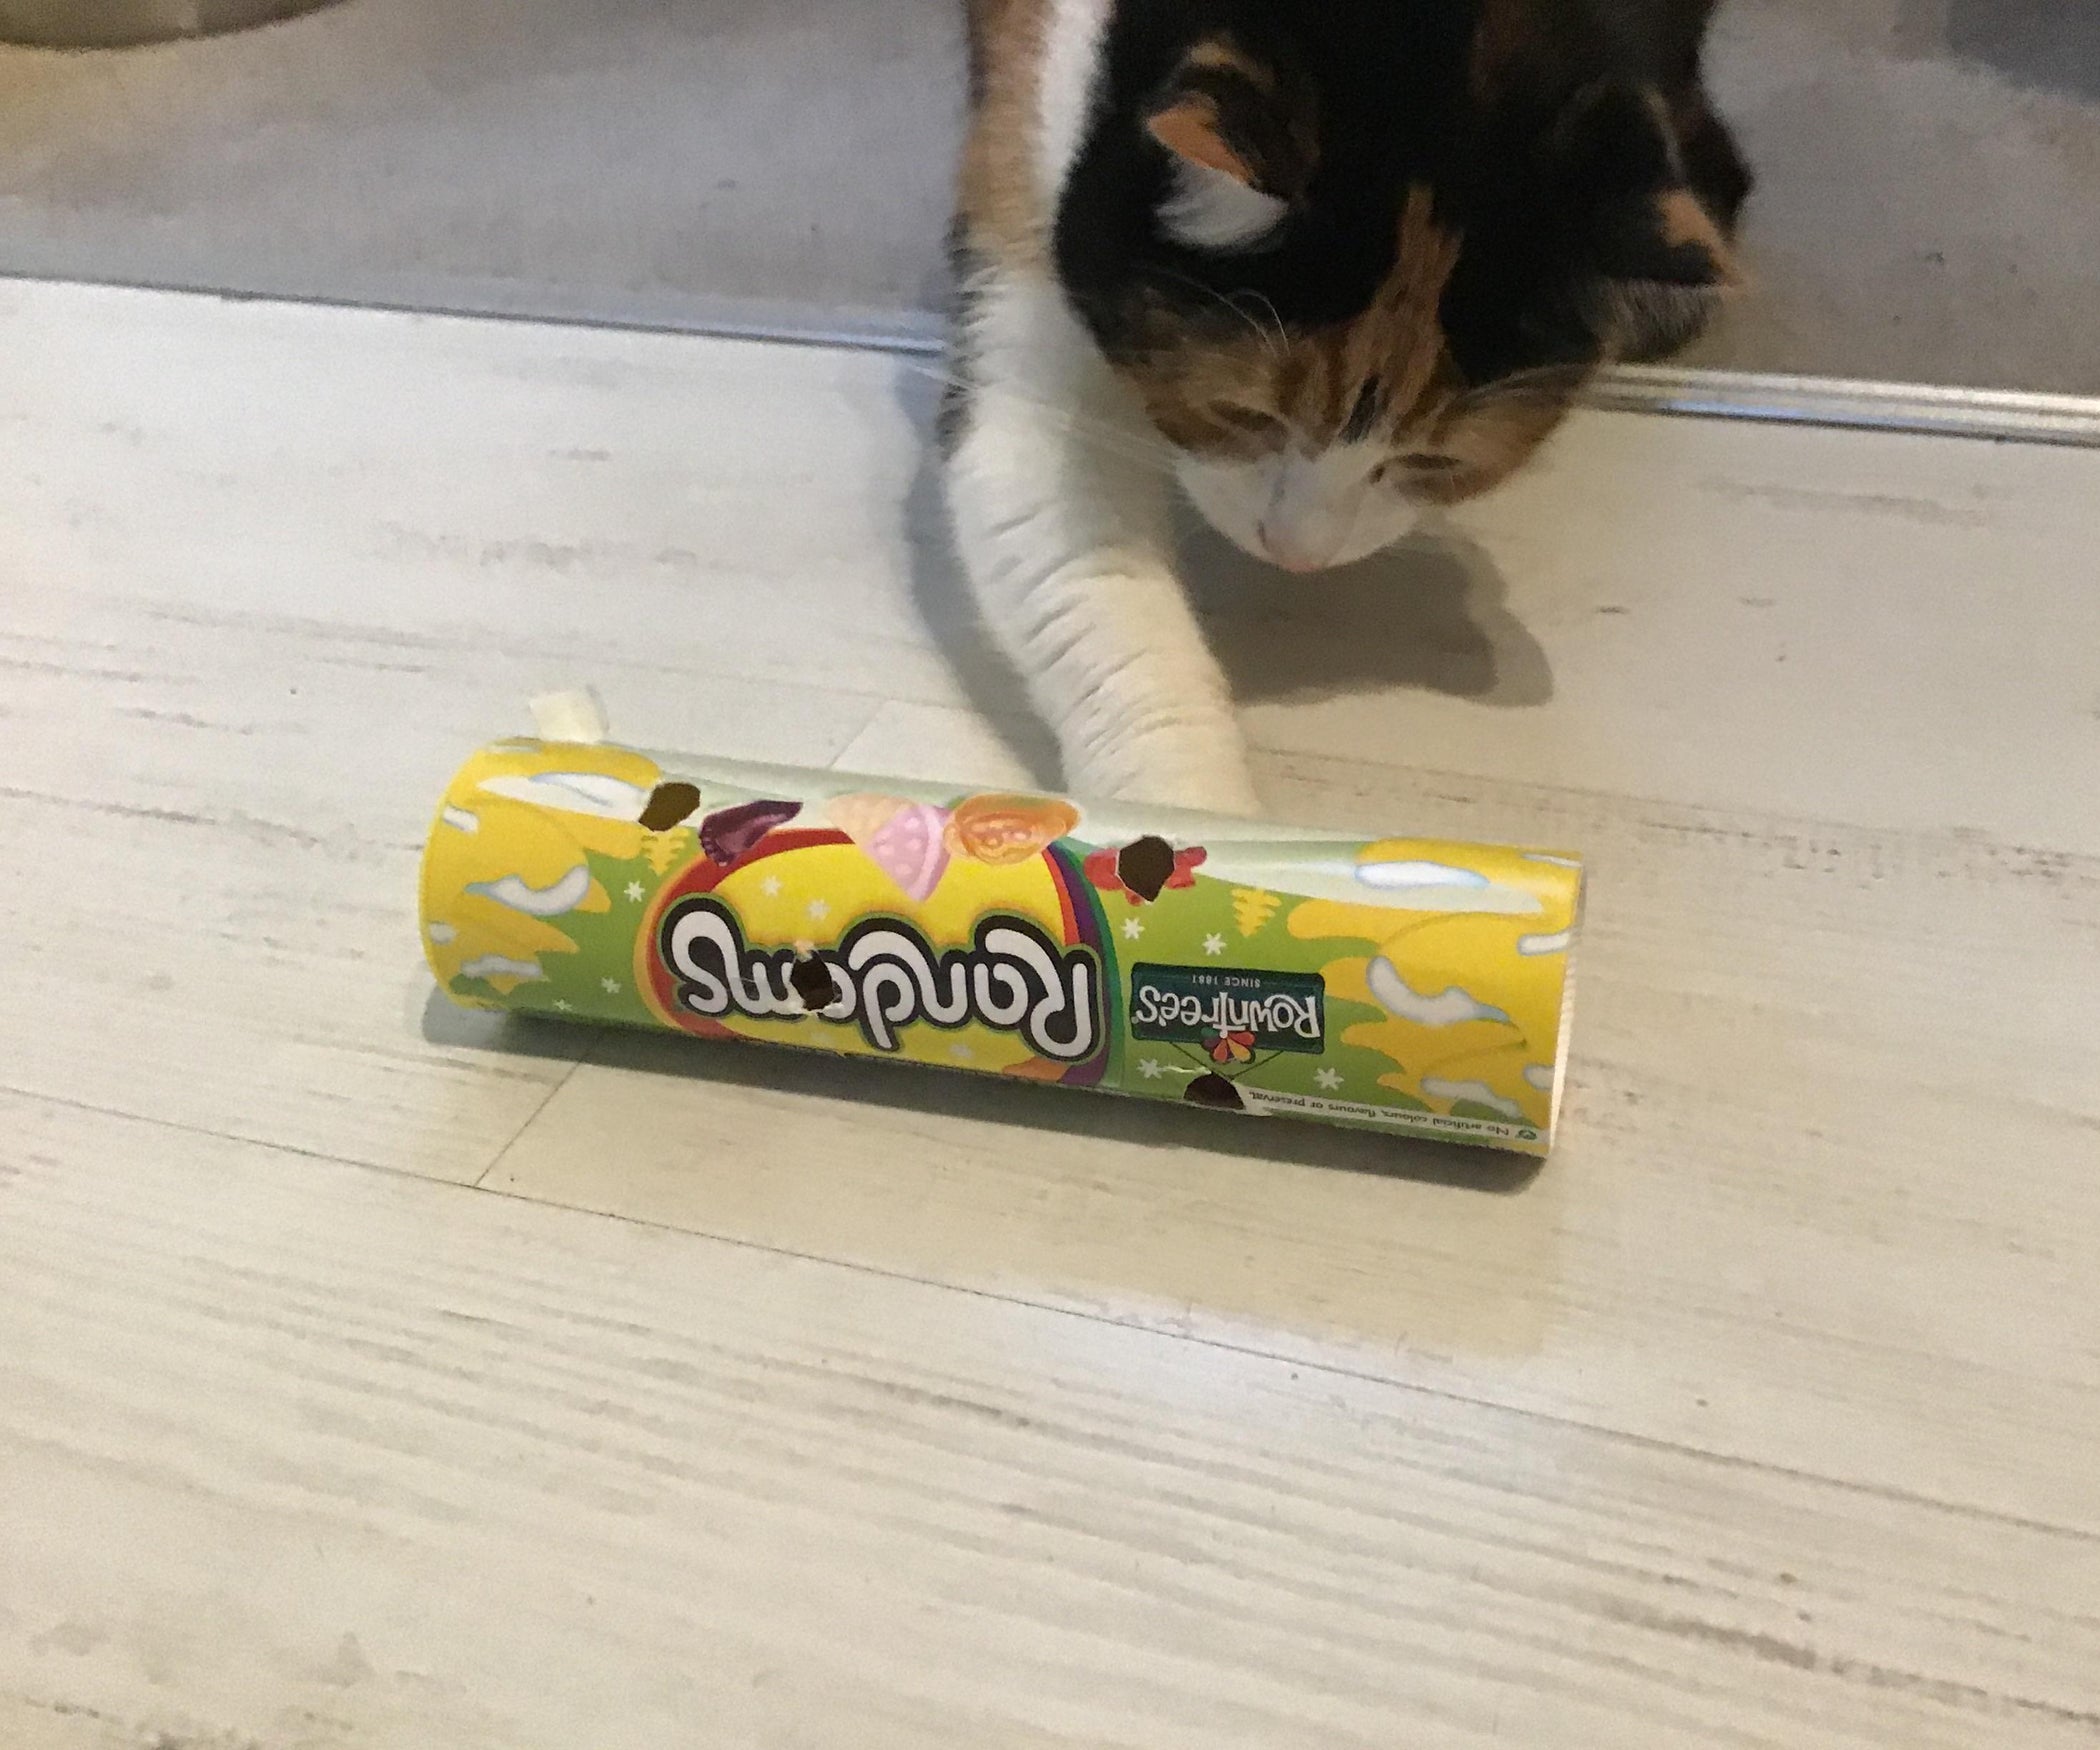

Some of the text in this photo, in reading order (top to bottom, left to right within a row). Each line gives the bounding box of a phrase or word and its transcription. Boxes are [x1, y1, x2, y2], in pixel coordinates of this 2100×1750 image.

[1192, 974, 1261, 988] SINCE 1881
[1309, 1101, 1324, 1109] or
[1328, 1104, 1376, 1118] flavours
[1432, 1117, 1481, 1129] artificial
[1486, 1124, 1509, 1136] No
